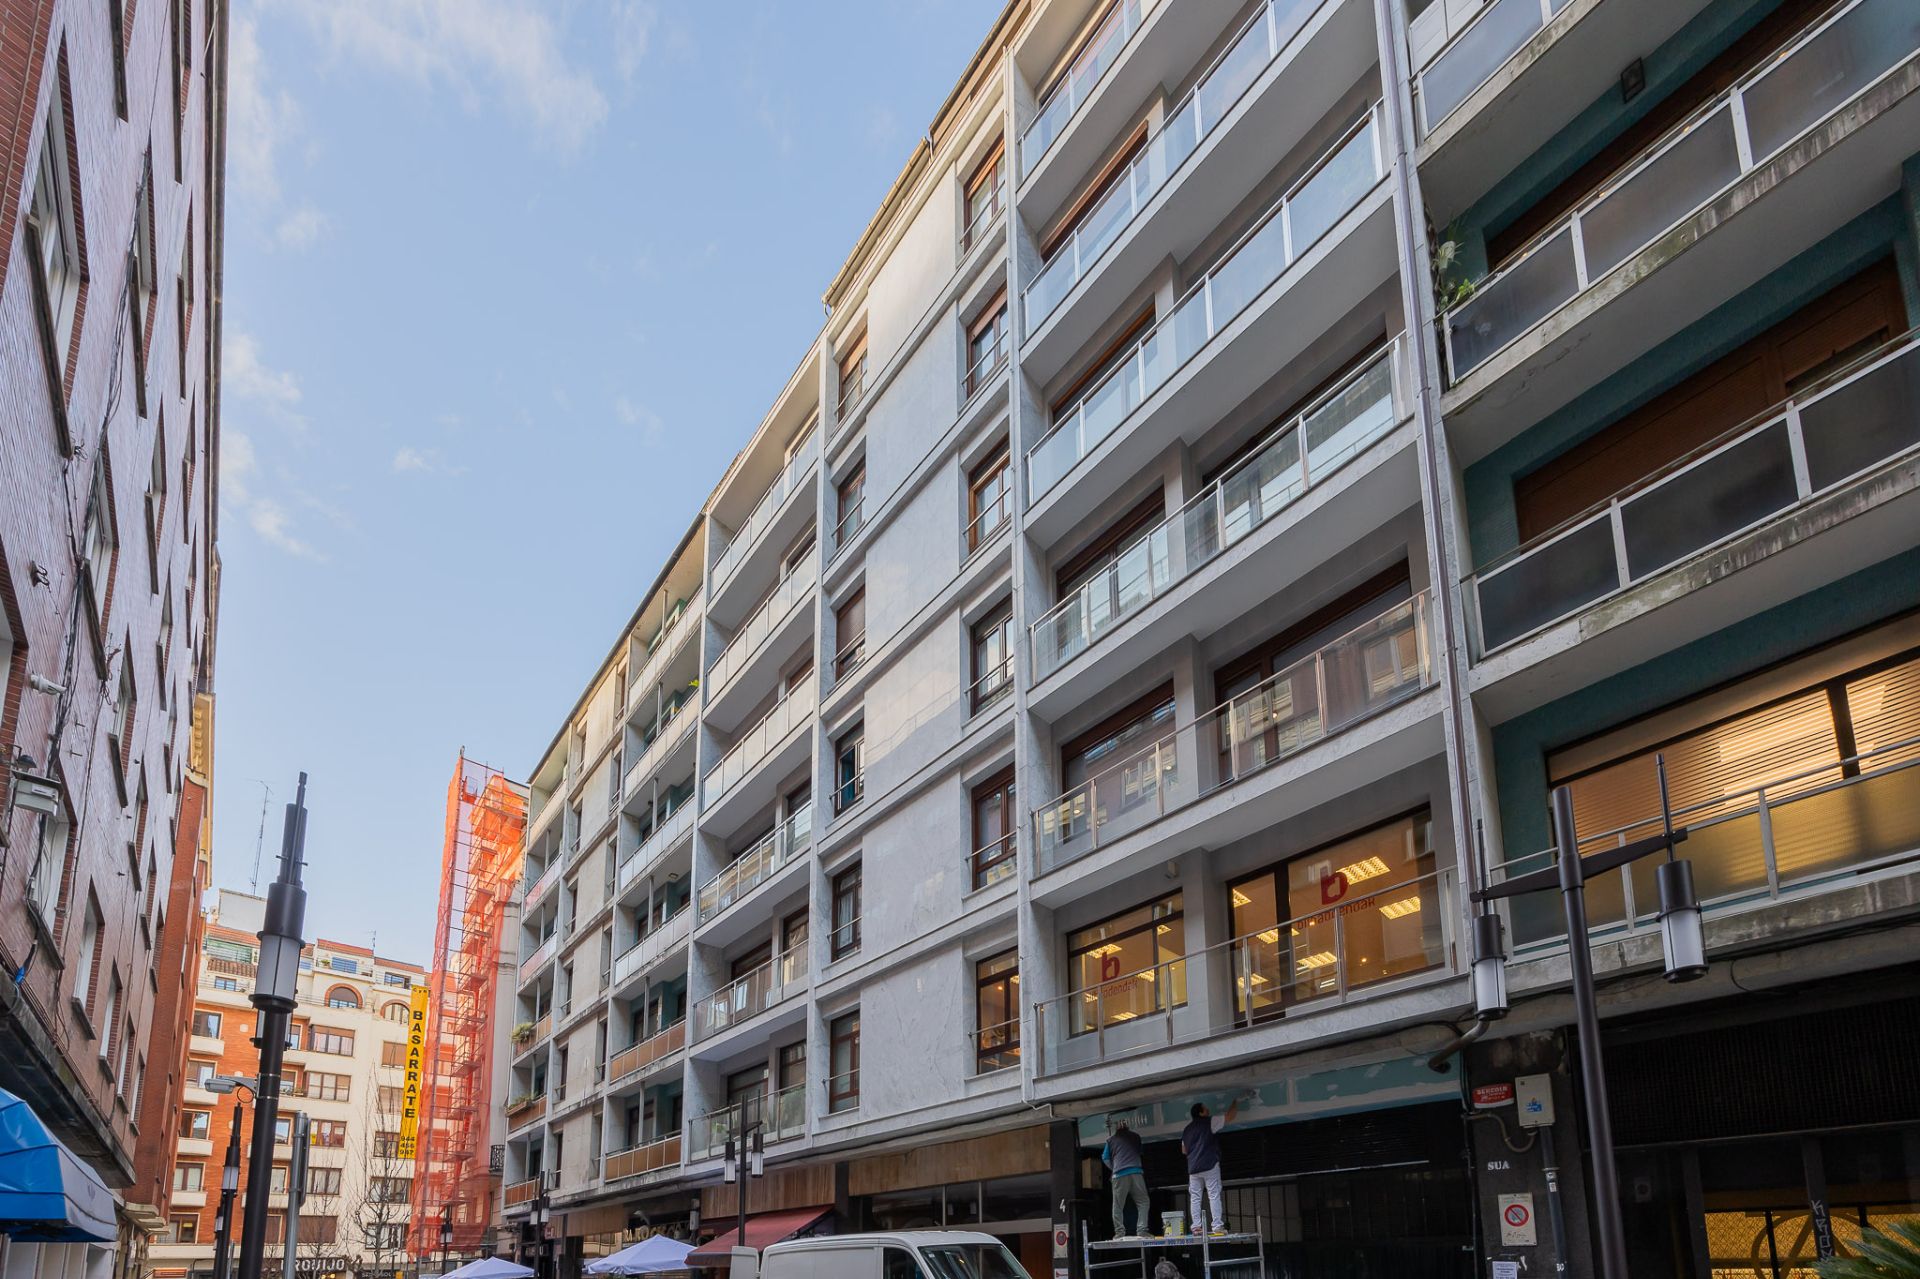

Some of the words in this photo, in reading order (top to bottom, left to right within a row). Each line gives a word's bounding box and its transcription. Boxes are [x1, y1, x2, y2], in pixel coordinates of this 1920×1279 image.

[404, 1010, 423, 1119] BASARRATE
[1487, 1160, 1510, 1171] SUA
[1059, 1198, 1066, 1213] 4
